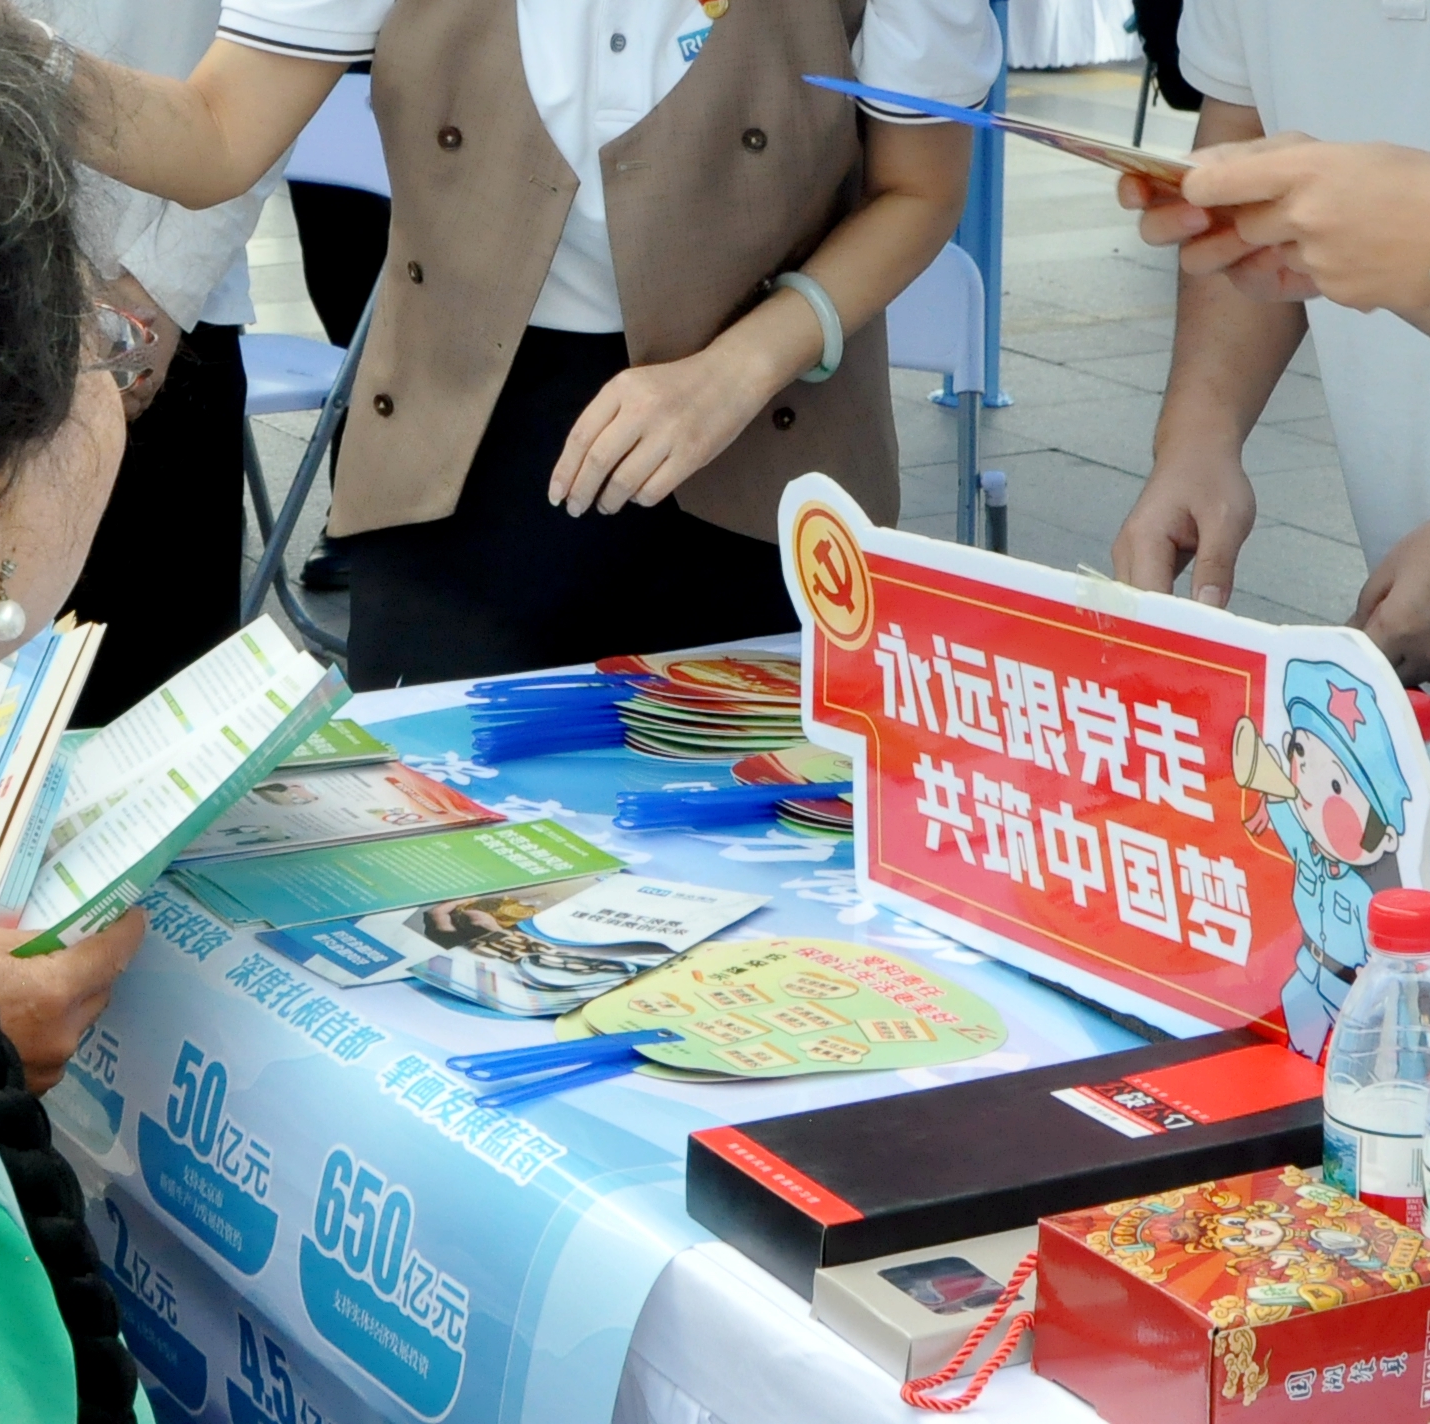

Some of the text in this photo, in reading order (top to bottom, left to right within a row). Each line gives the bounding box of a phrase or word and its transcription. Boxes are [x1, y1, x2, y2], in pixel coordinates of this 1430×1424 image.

[874, 622, 1214, 824] 永远跟党走
[913, 752, 1254, 968] 共筑中国梦
[139, 888, 232, 962] 在京投资
[225, 952, 386, 1062] 深度扎根首都
[379, 1055, 567, 1183] 擘画发展蓝图
[795, 947, 960, 1023] 保险让生活更美好
[859, 956, 946, 998] 爱和责任
[167, 1041, 271, 1198] 50亿元
[315, 1148, 467, 1344] 650亿元
[333, 1288, 429, 1378] 支持实体经济发展投资
